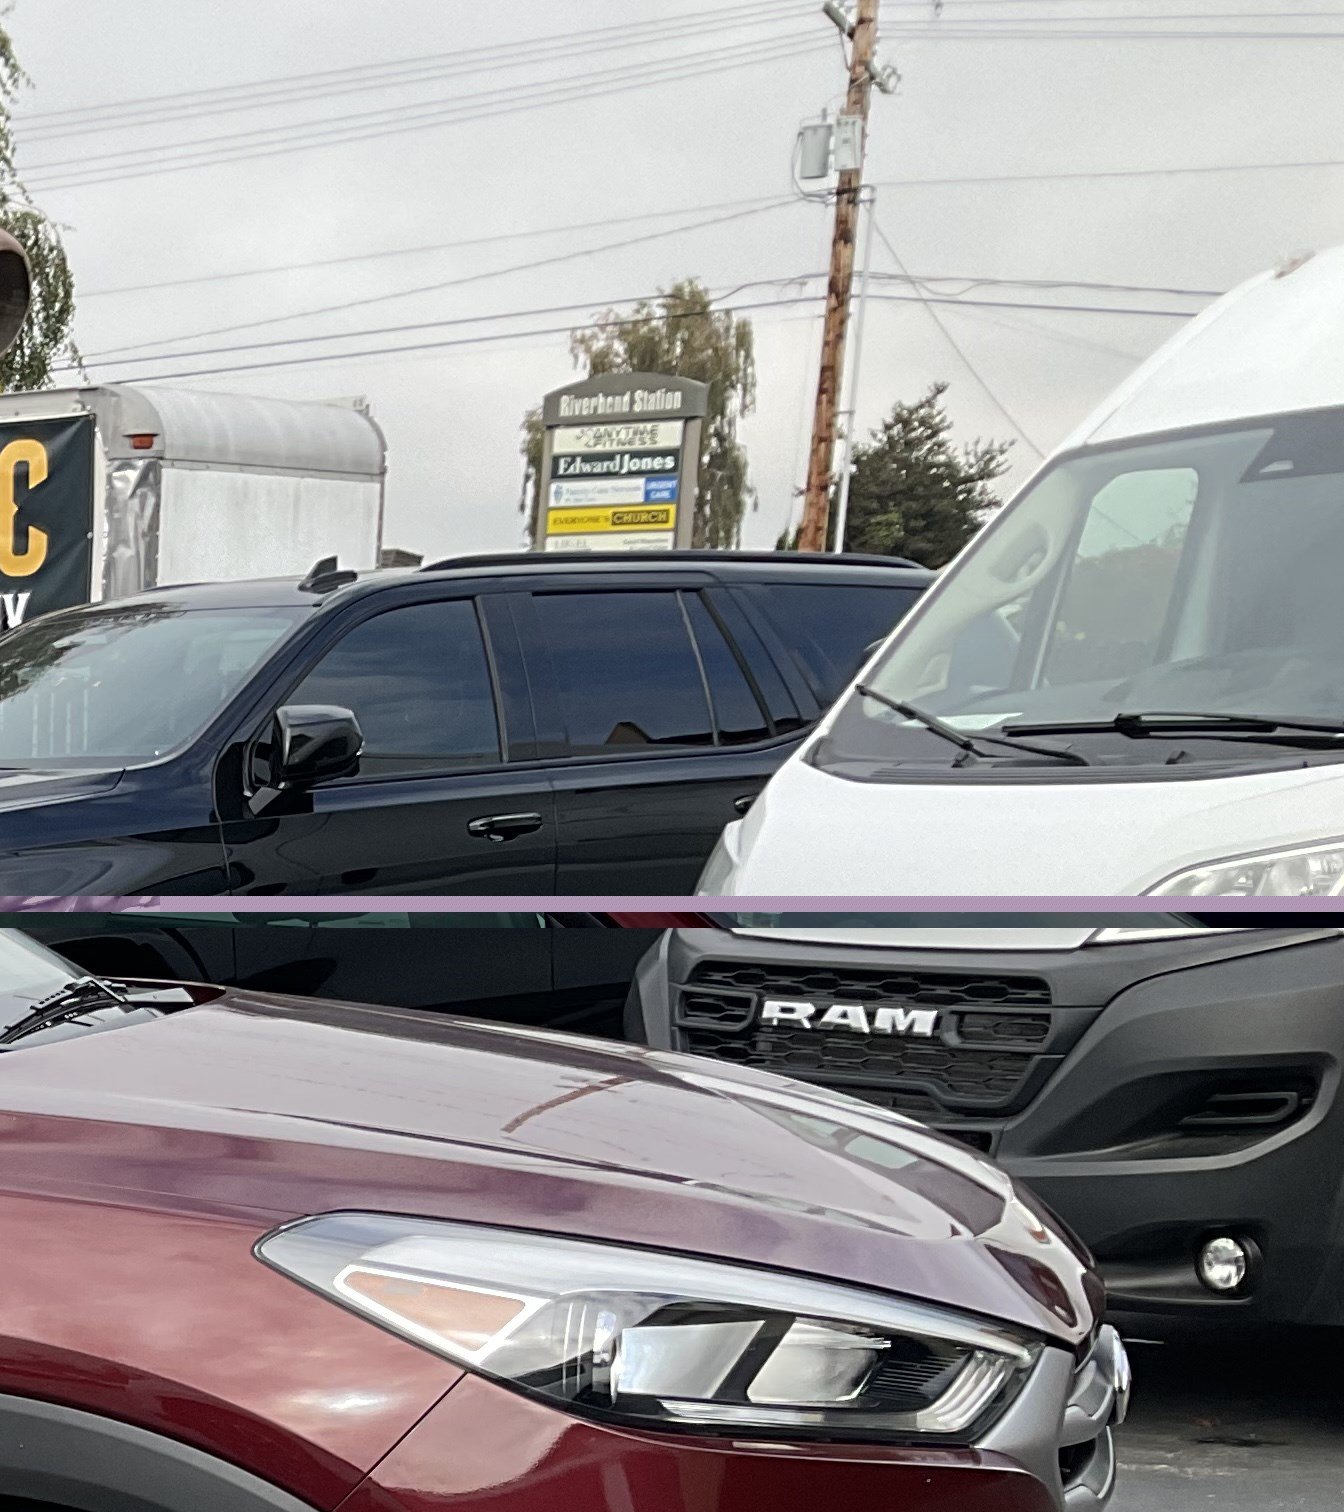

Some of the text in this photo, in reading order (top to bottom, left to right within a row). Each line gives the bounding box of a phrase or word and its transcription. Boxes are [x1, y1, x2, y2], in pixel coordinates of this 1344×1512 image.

[633, 388, 682, 412] Station
[593, 424, 659, 439] ANYTIME
[591, 436, 658, 448] FITNESS
[613, 511, 667, 524] CHURCH
[761, 1000, 939, 1037] RAM
